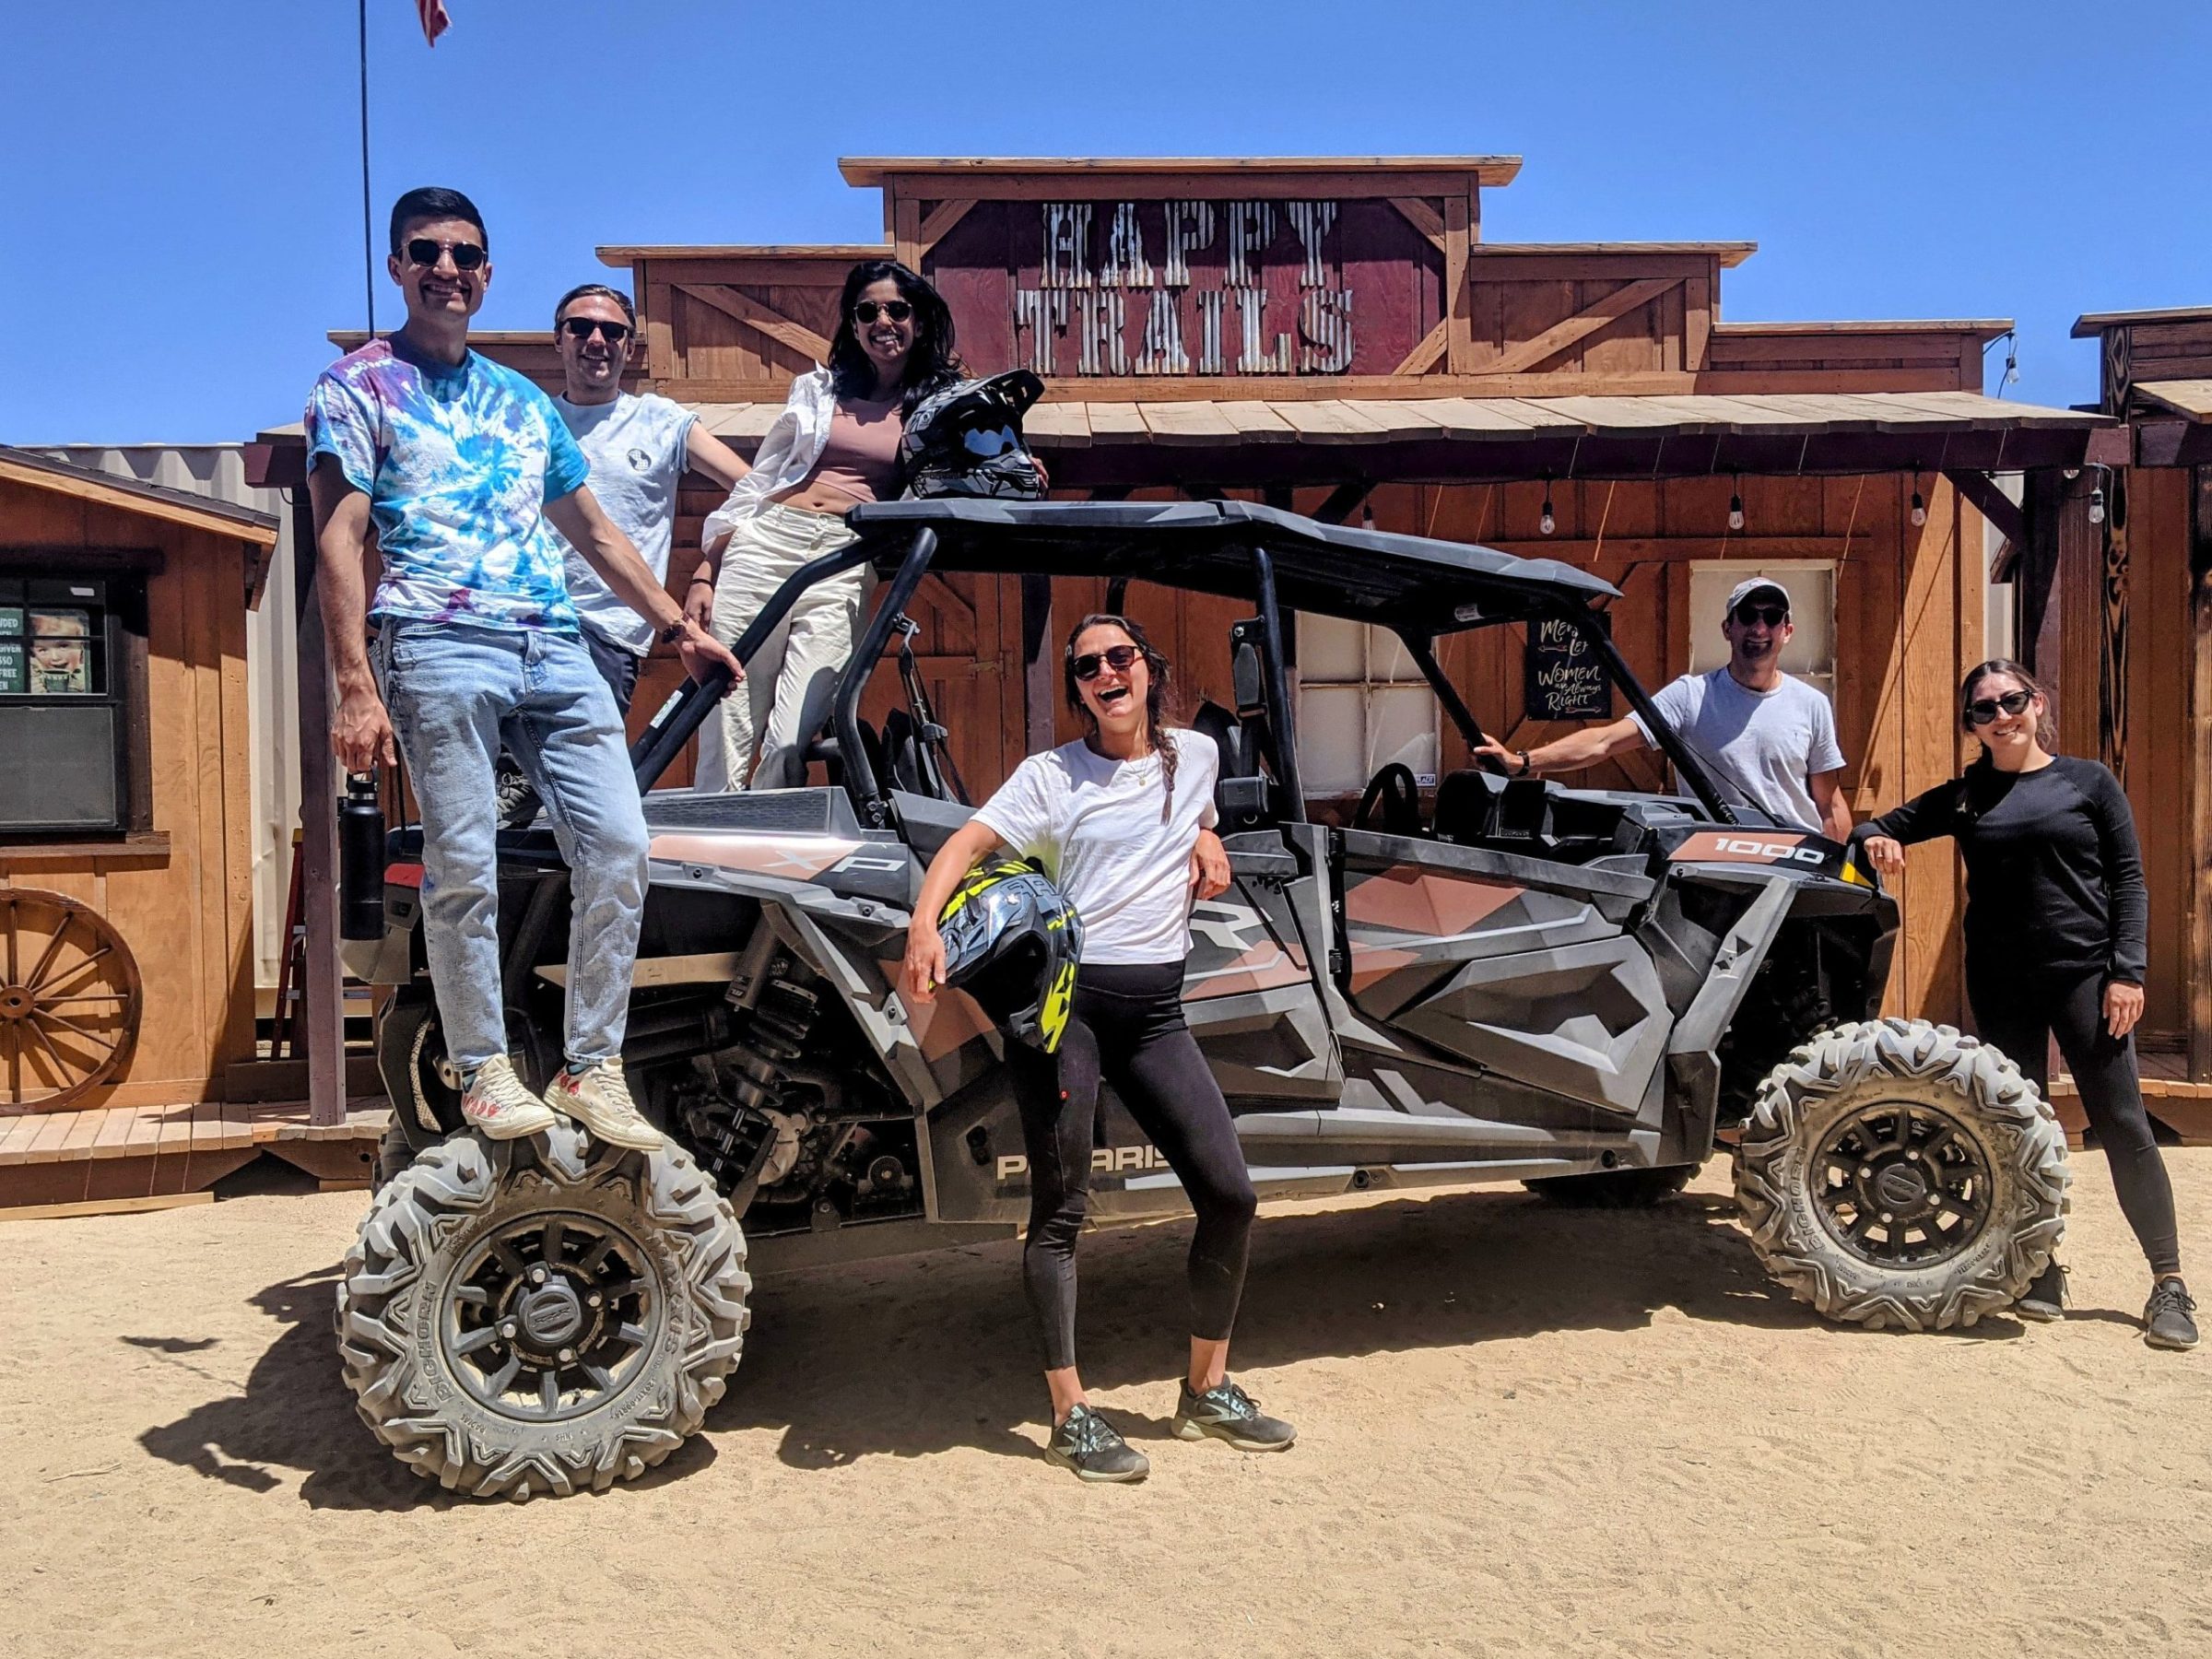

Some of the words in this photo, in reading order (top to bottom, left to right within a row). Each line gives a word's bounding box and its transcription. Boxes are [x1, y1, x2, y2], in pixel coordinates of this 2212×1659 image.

[1040, 201, 1339, 288] HAPPY
[1016, 289, 1355, 376] TRAILS
[1714, 838, 1825, 865] 1000
[416, 1280, 455, 1403] BIGHORN
